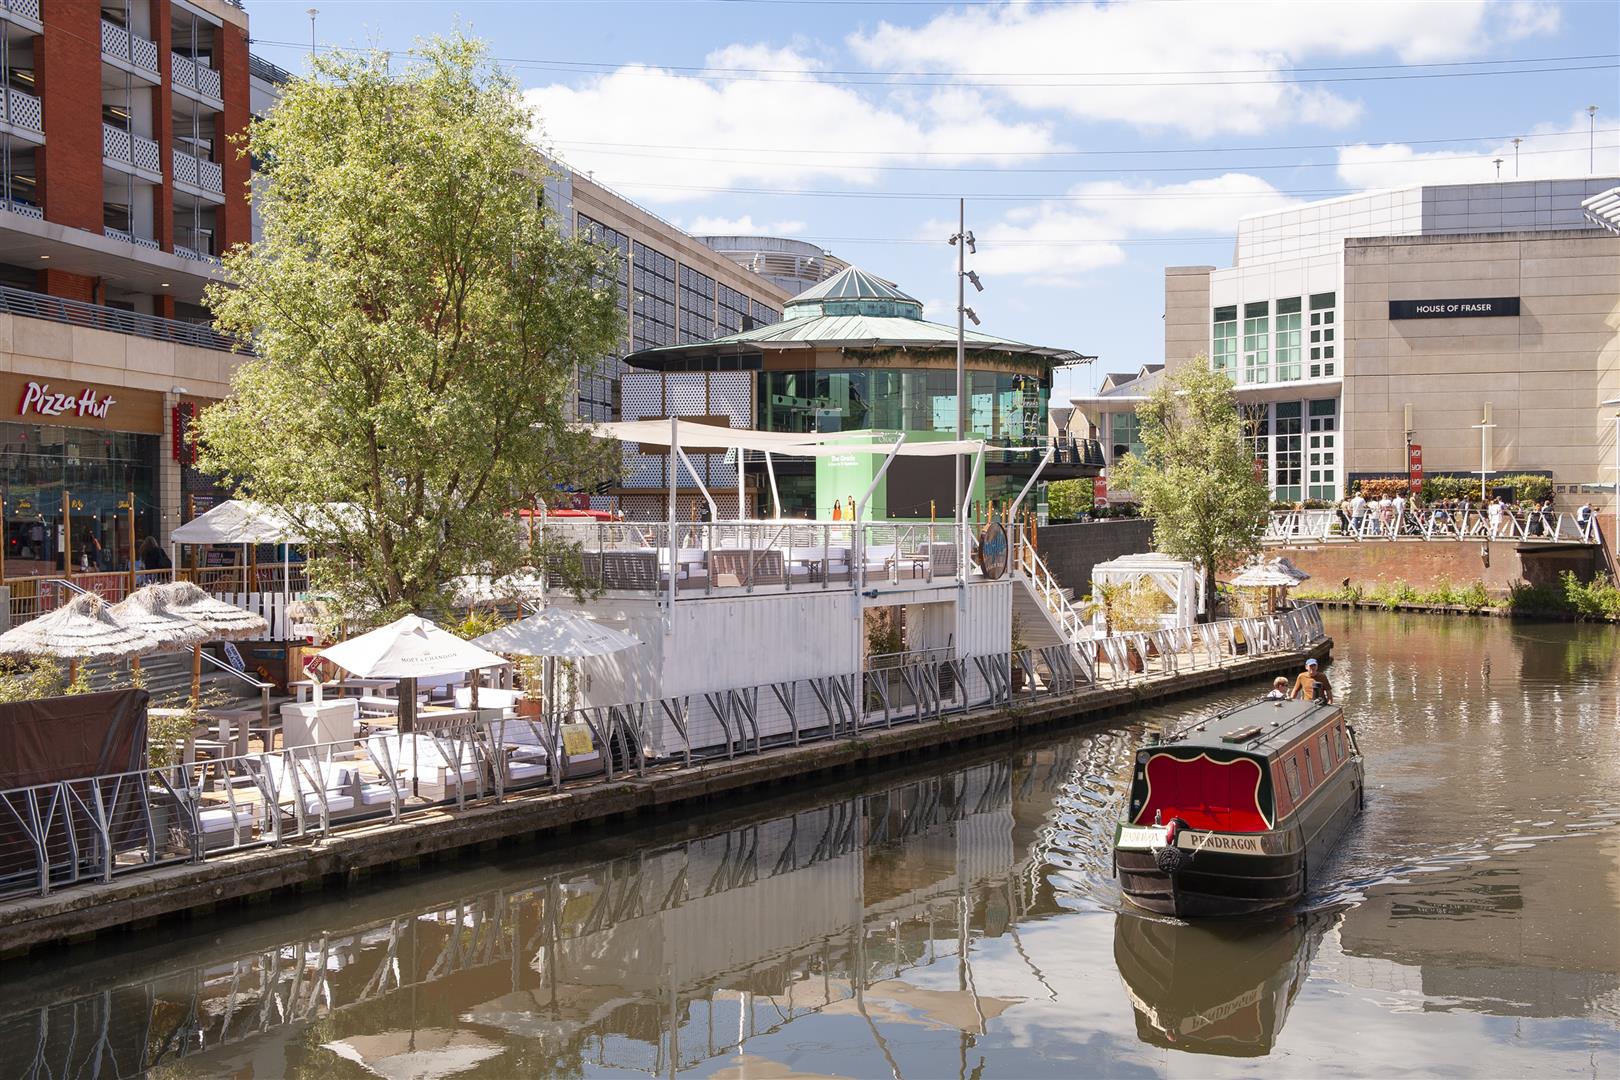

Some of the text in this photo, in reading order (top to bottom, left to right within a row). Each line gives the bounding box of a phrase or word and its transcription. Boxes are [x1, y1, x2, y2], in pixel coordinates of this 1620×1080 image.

[1416, 303, 1492, 313] HOUSE OF FRASER
[20, 382, 117, 419] Pizza Hut
